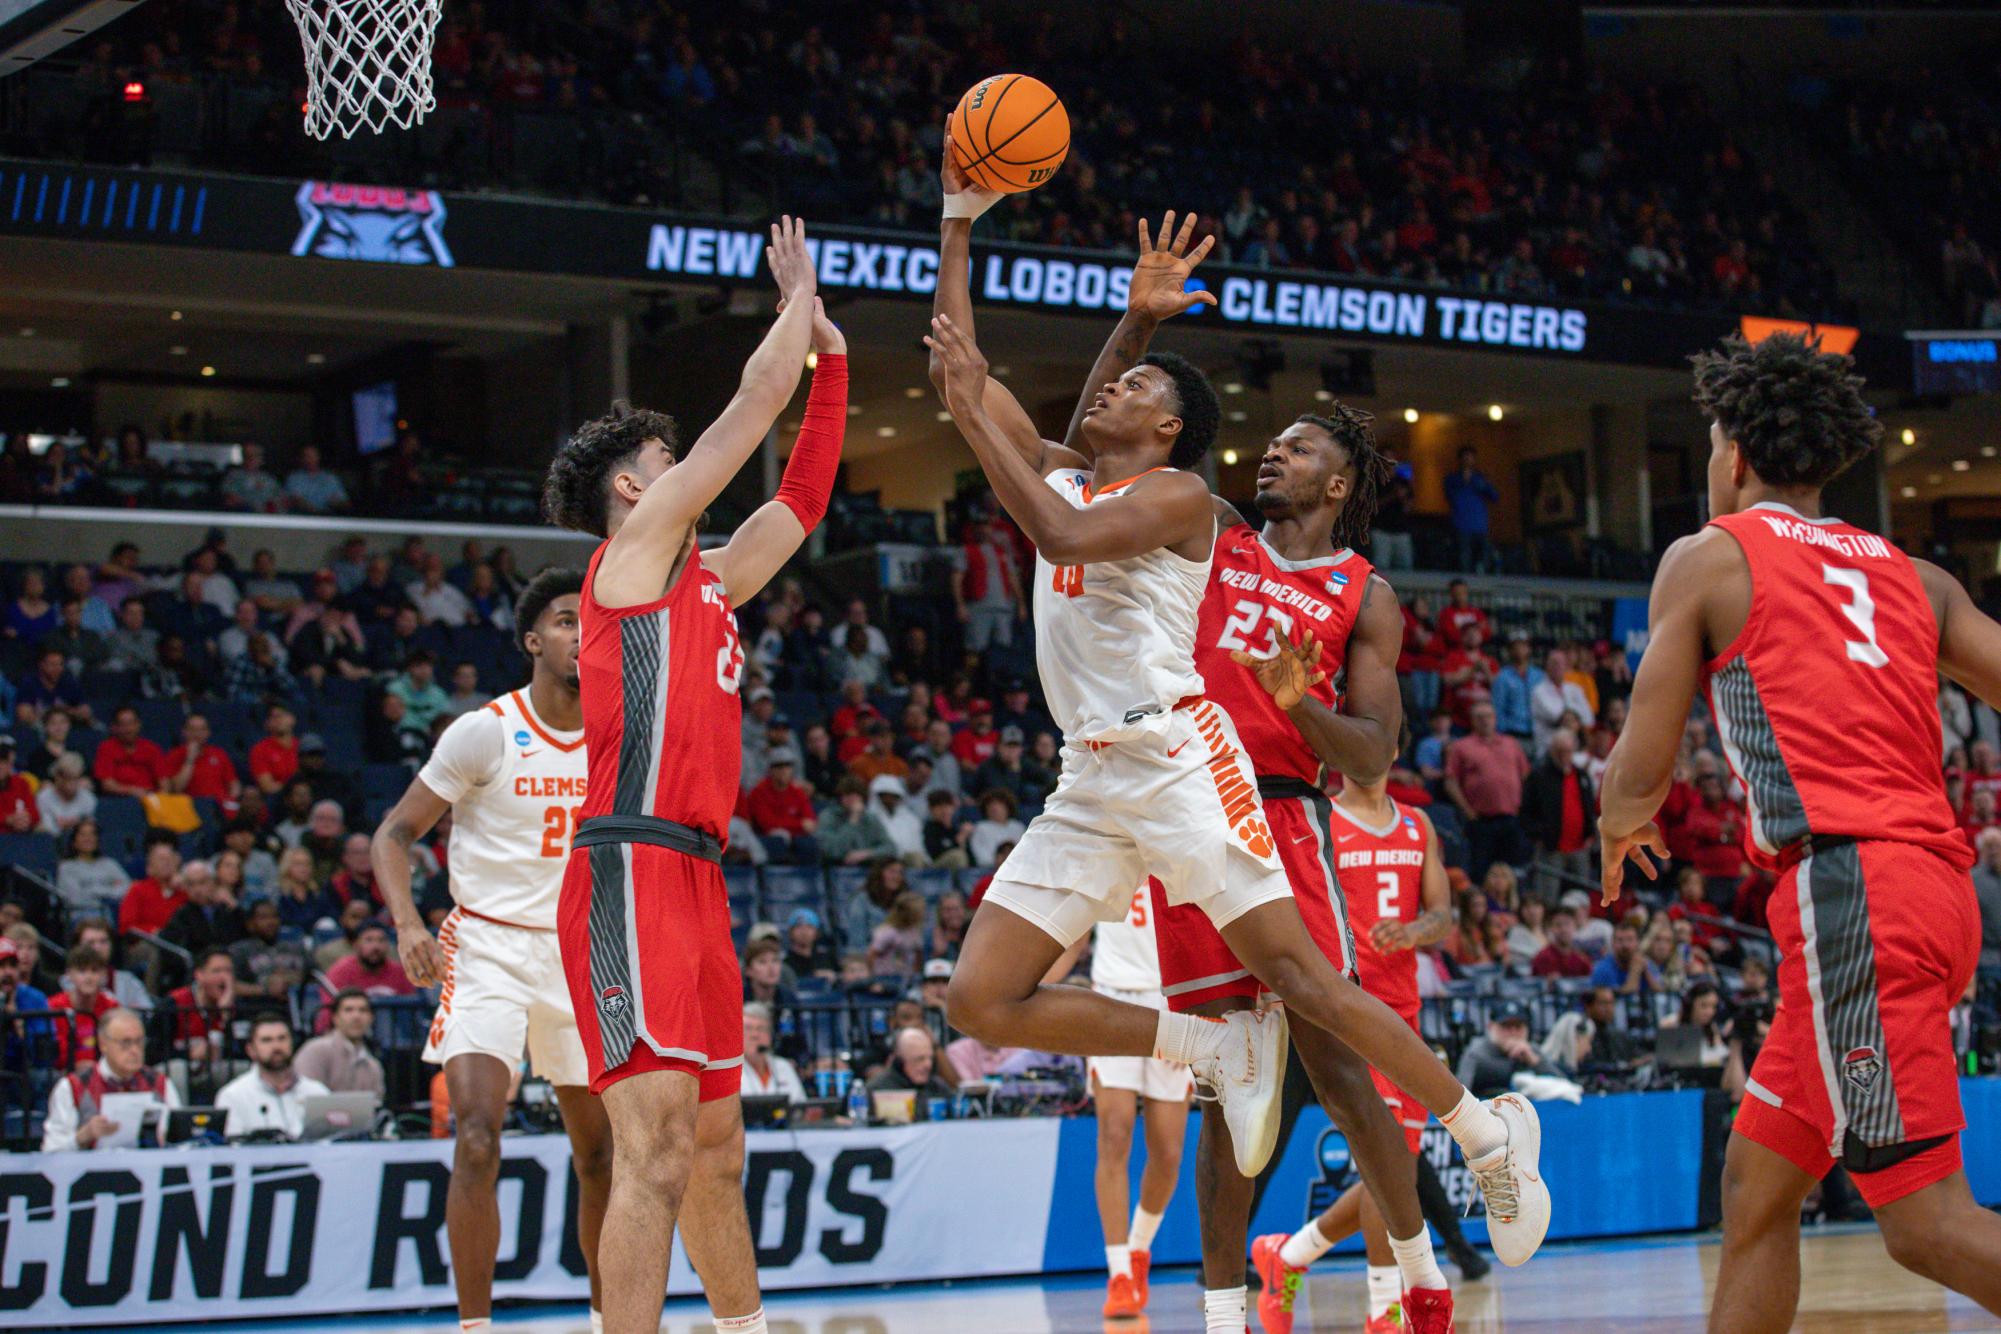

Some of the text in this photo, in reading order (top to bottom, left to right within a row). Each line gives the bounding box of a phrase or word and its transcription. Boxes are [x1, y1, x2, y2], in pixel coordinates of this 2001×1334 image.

[646, 224, 1135, 312] NEW EXIC LOBOS
[1220, 277, 1588, 351] CLEMSON TIGERS
[1219, 567, 1262, 592] NEW
[1259, 578, 1333, 622] MEXICO
[1821, 561, 1890, 669] 3
[1216, 598, 1294, 660] 23
[1339, 849, 1424, 869] NEW MEXICO
[1377, 871, 1400, 918] 2
[0, 1147, 894, 1311] COND RODS
